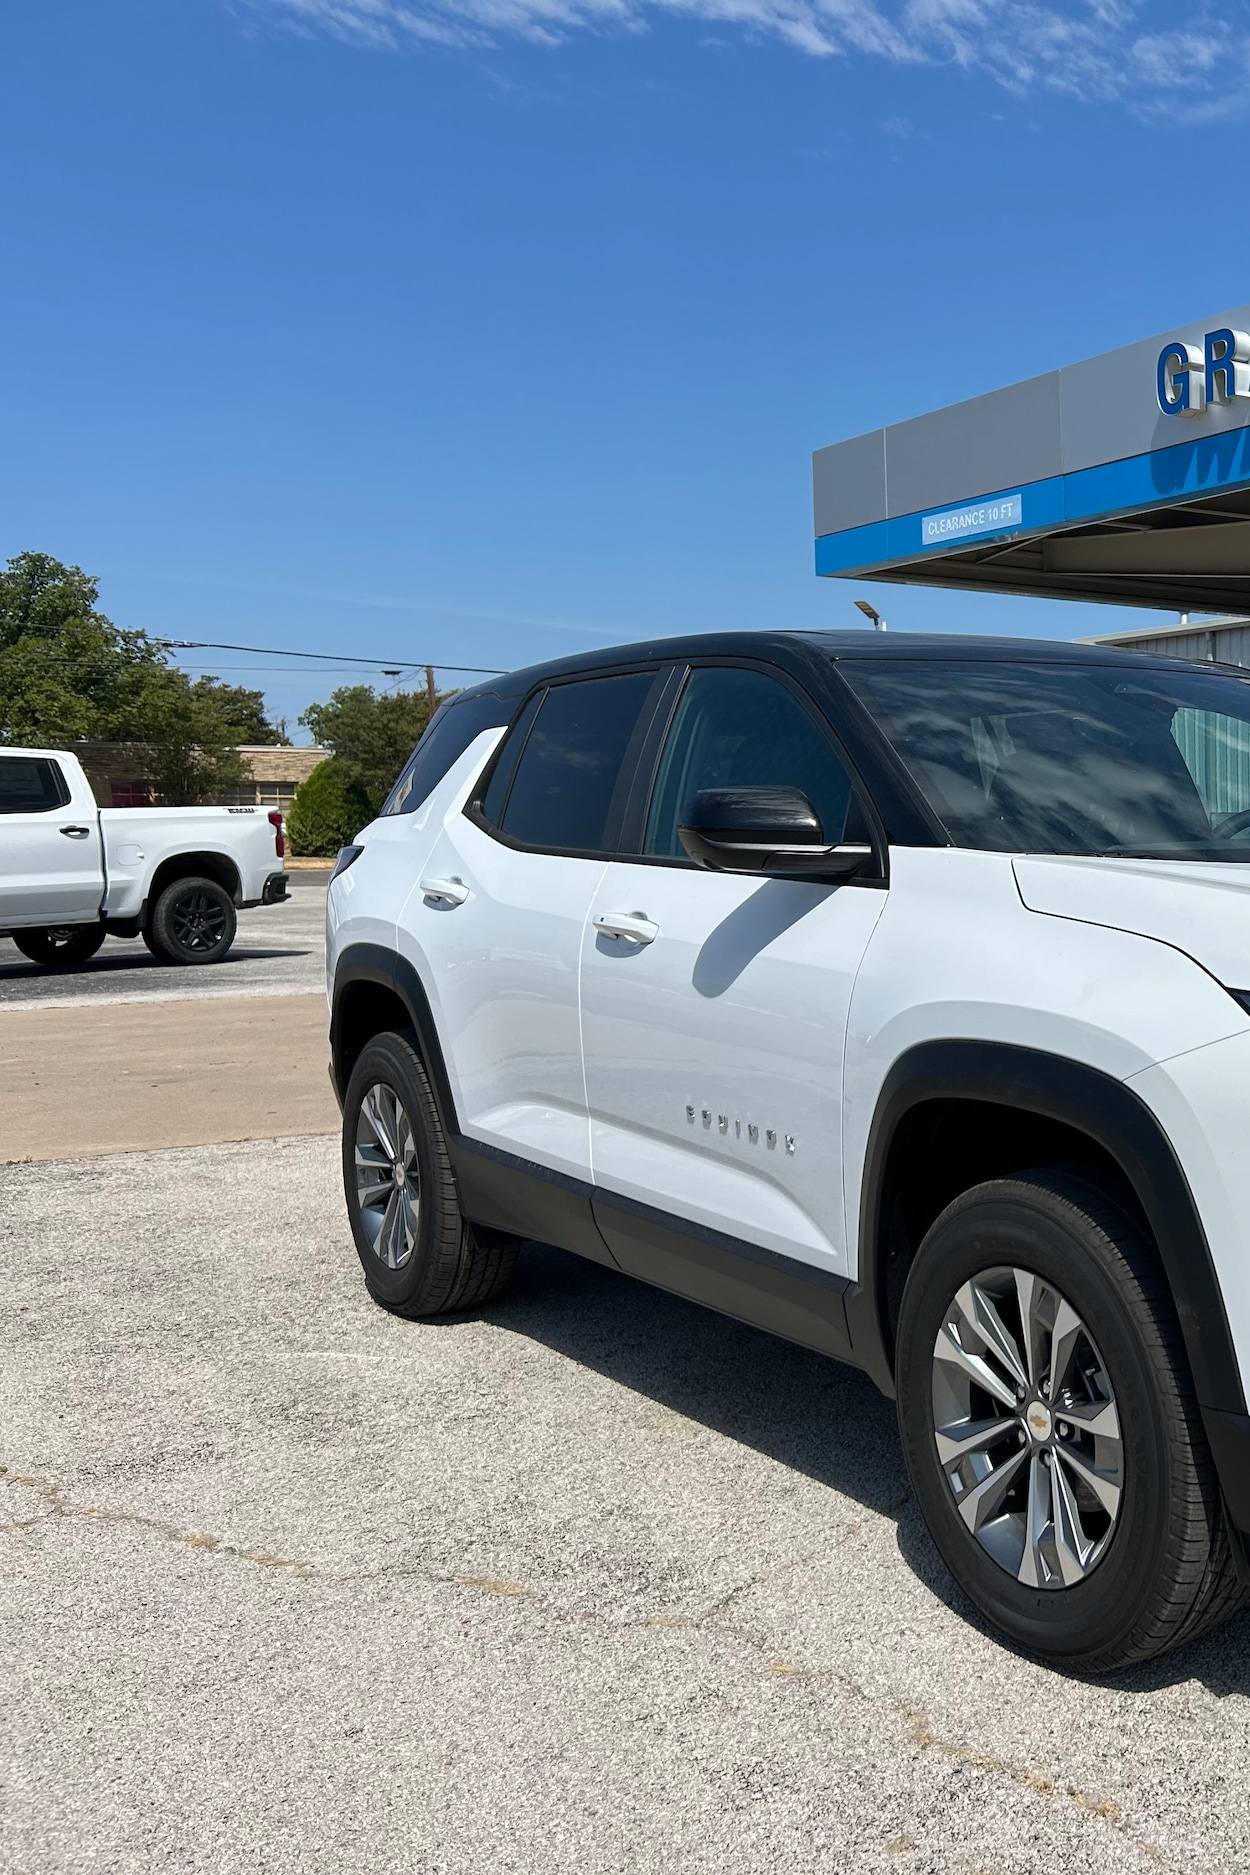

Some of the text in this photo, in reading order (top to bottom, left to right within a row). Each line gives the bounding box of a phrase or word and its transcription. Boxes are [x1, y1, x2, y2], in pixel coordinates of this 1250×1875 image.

[928, 503, 1013, 536] CLEARANCE 10 FT
[685, 1104, 796, 1154] EQUINOX
